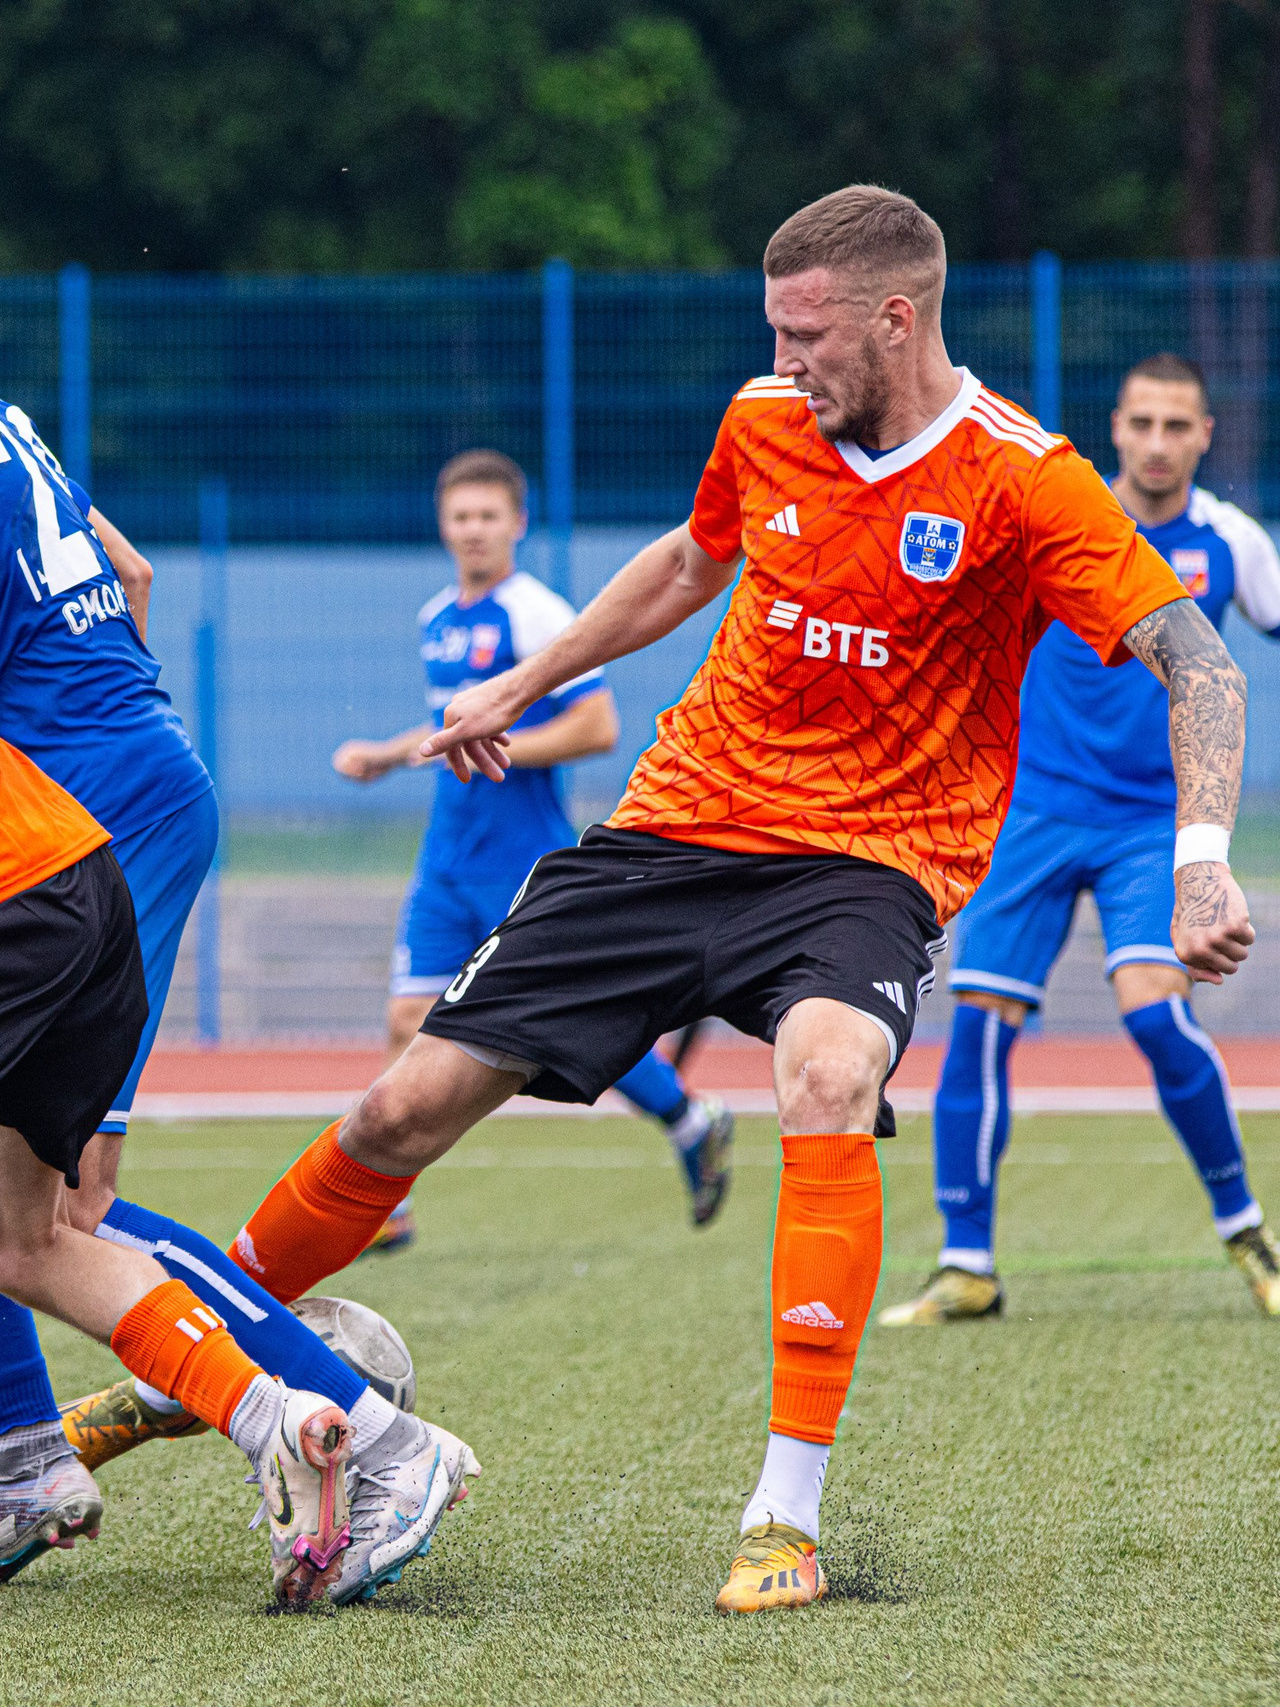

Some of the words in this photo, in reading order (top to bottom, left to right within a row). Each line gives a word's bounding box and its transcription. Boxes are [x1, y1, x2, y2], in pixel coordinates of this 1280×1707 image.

[915, 534, 947, 550] АТОМ
[803, 616, 890, 668] ВТБ
[781, 1312, 844, 1329] adidas
